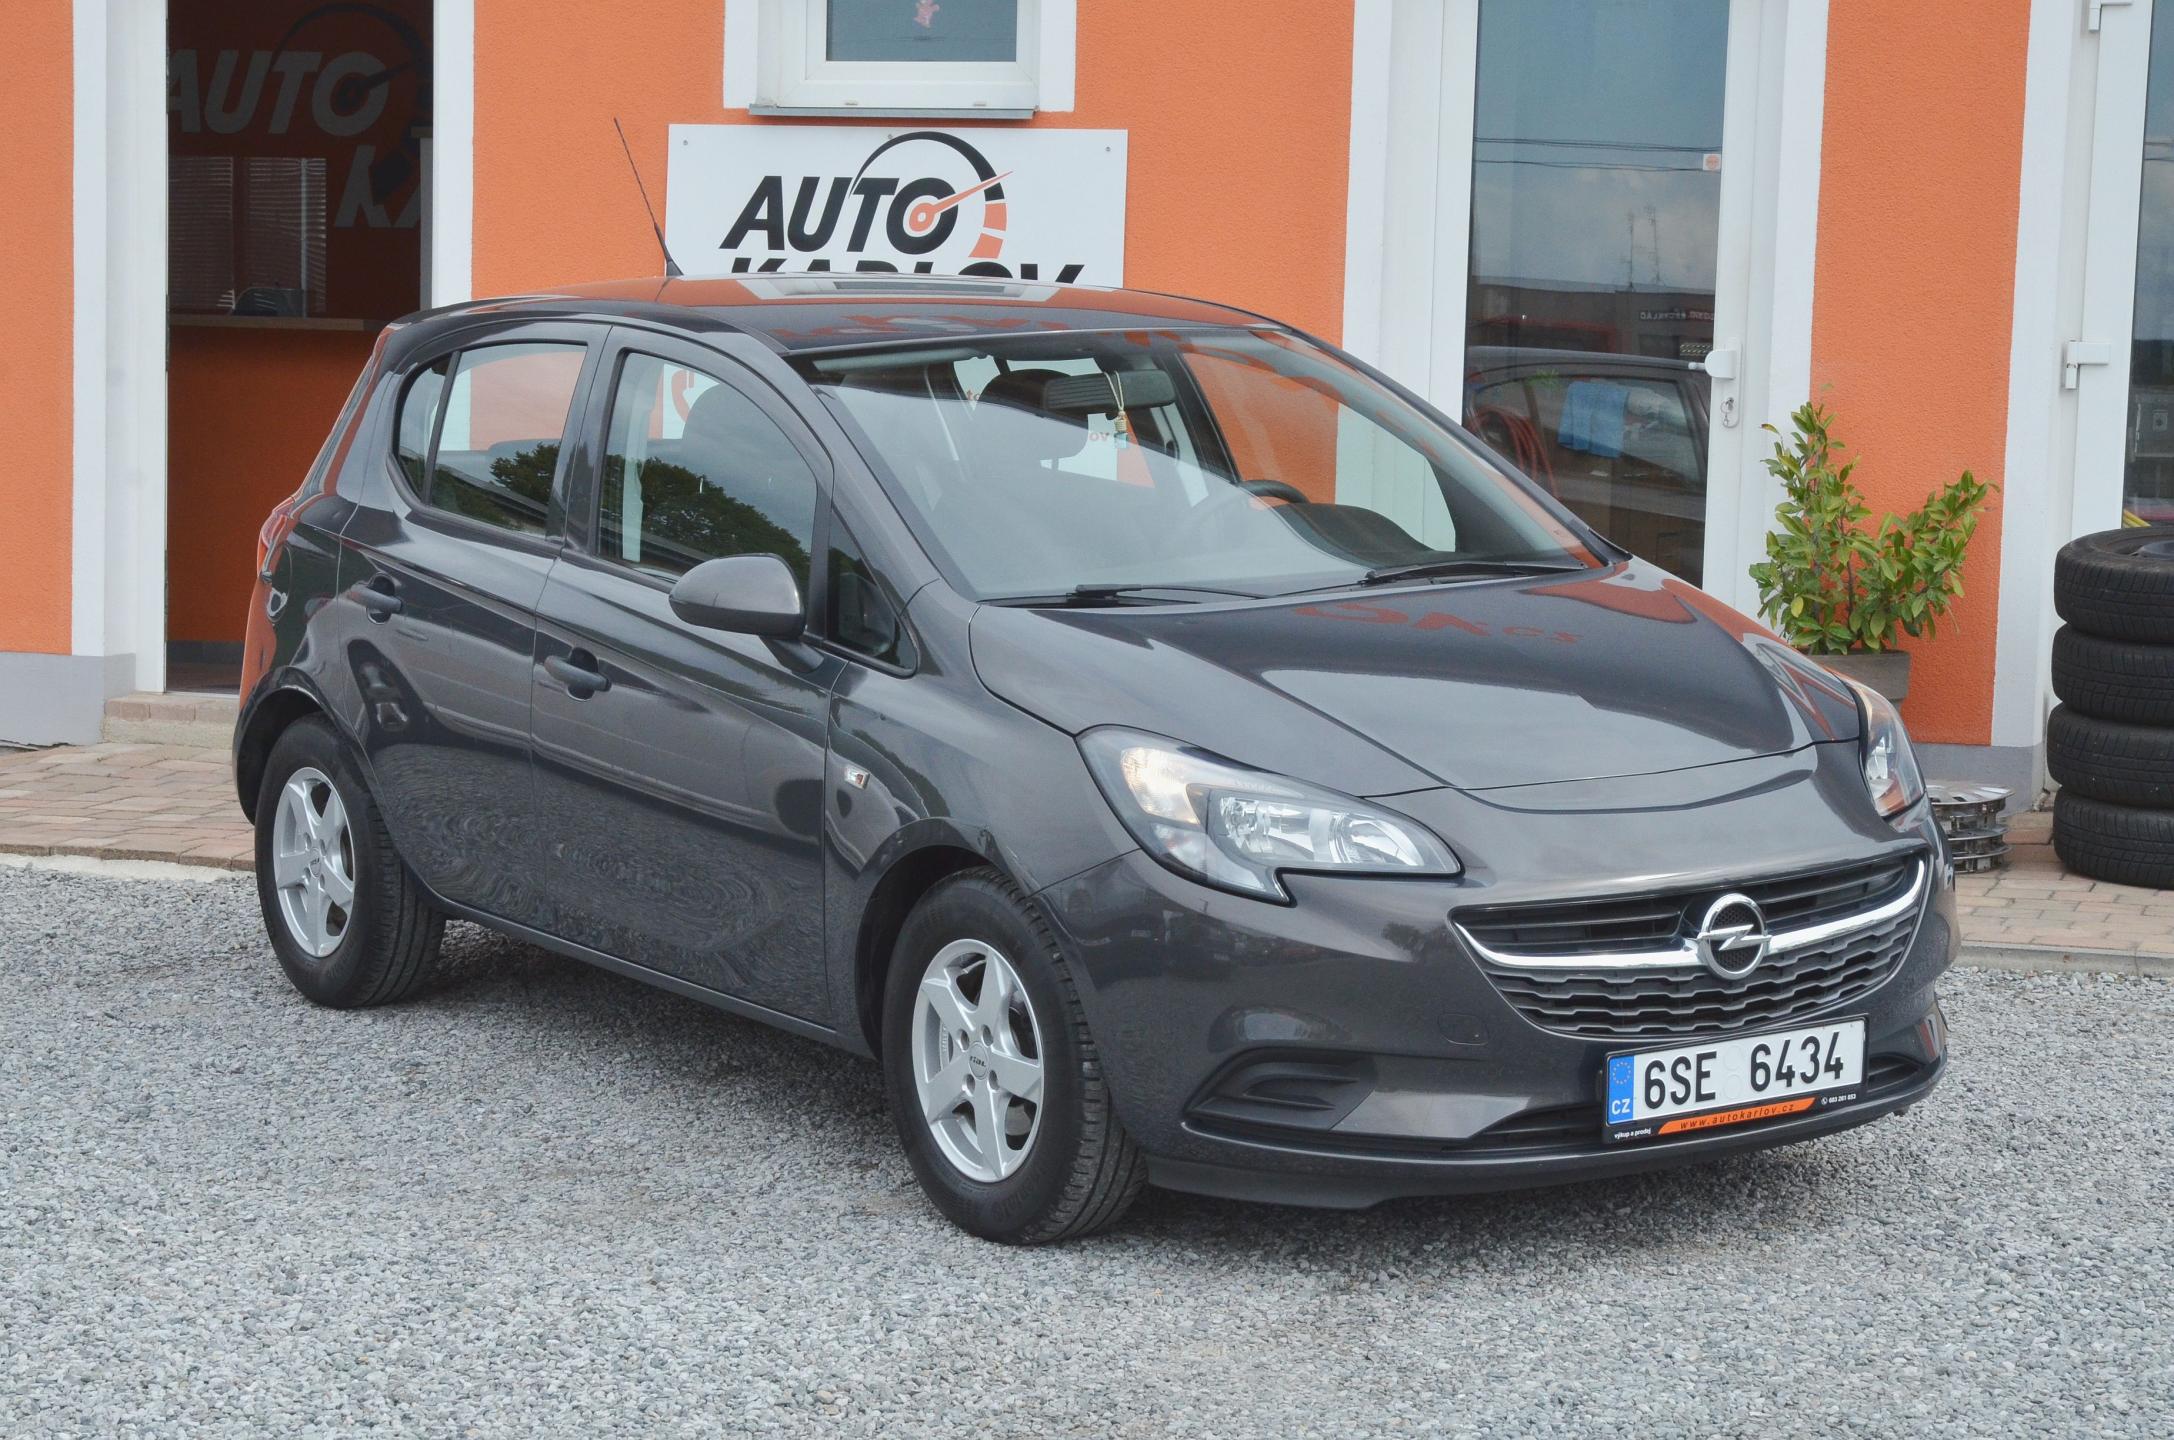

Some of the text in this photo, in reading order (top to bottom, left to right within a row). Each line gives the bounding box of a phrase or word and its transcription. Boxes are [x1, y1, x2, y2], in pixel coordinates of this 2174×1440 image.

[167, 49, 390, 137] AUTO
[719, 175, 959, 255] AUTO
[1612, 1098, 1631, 1115] CZ
[1644, 1031, 1844, 1110] 6SE 6434
[1680, 1103, 1795, 1129] www.autokarlov.cz
